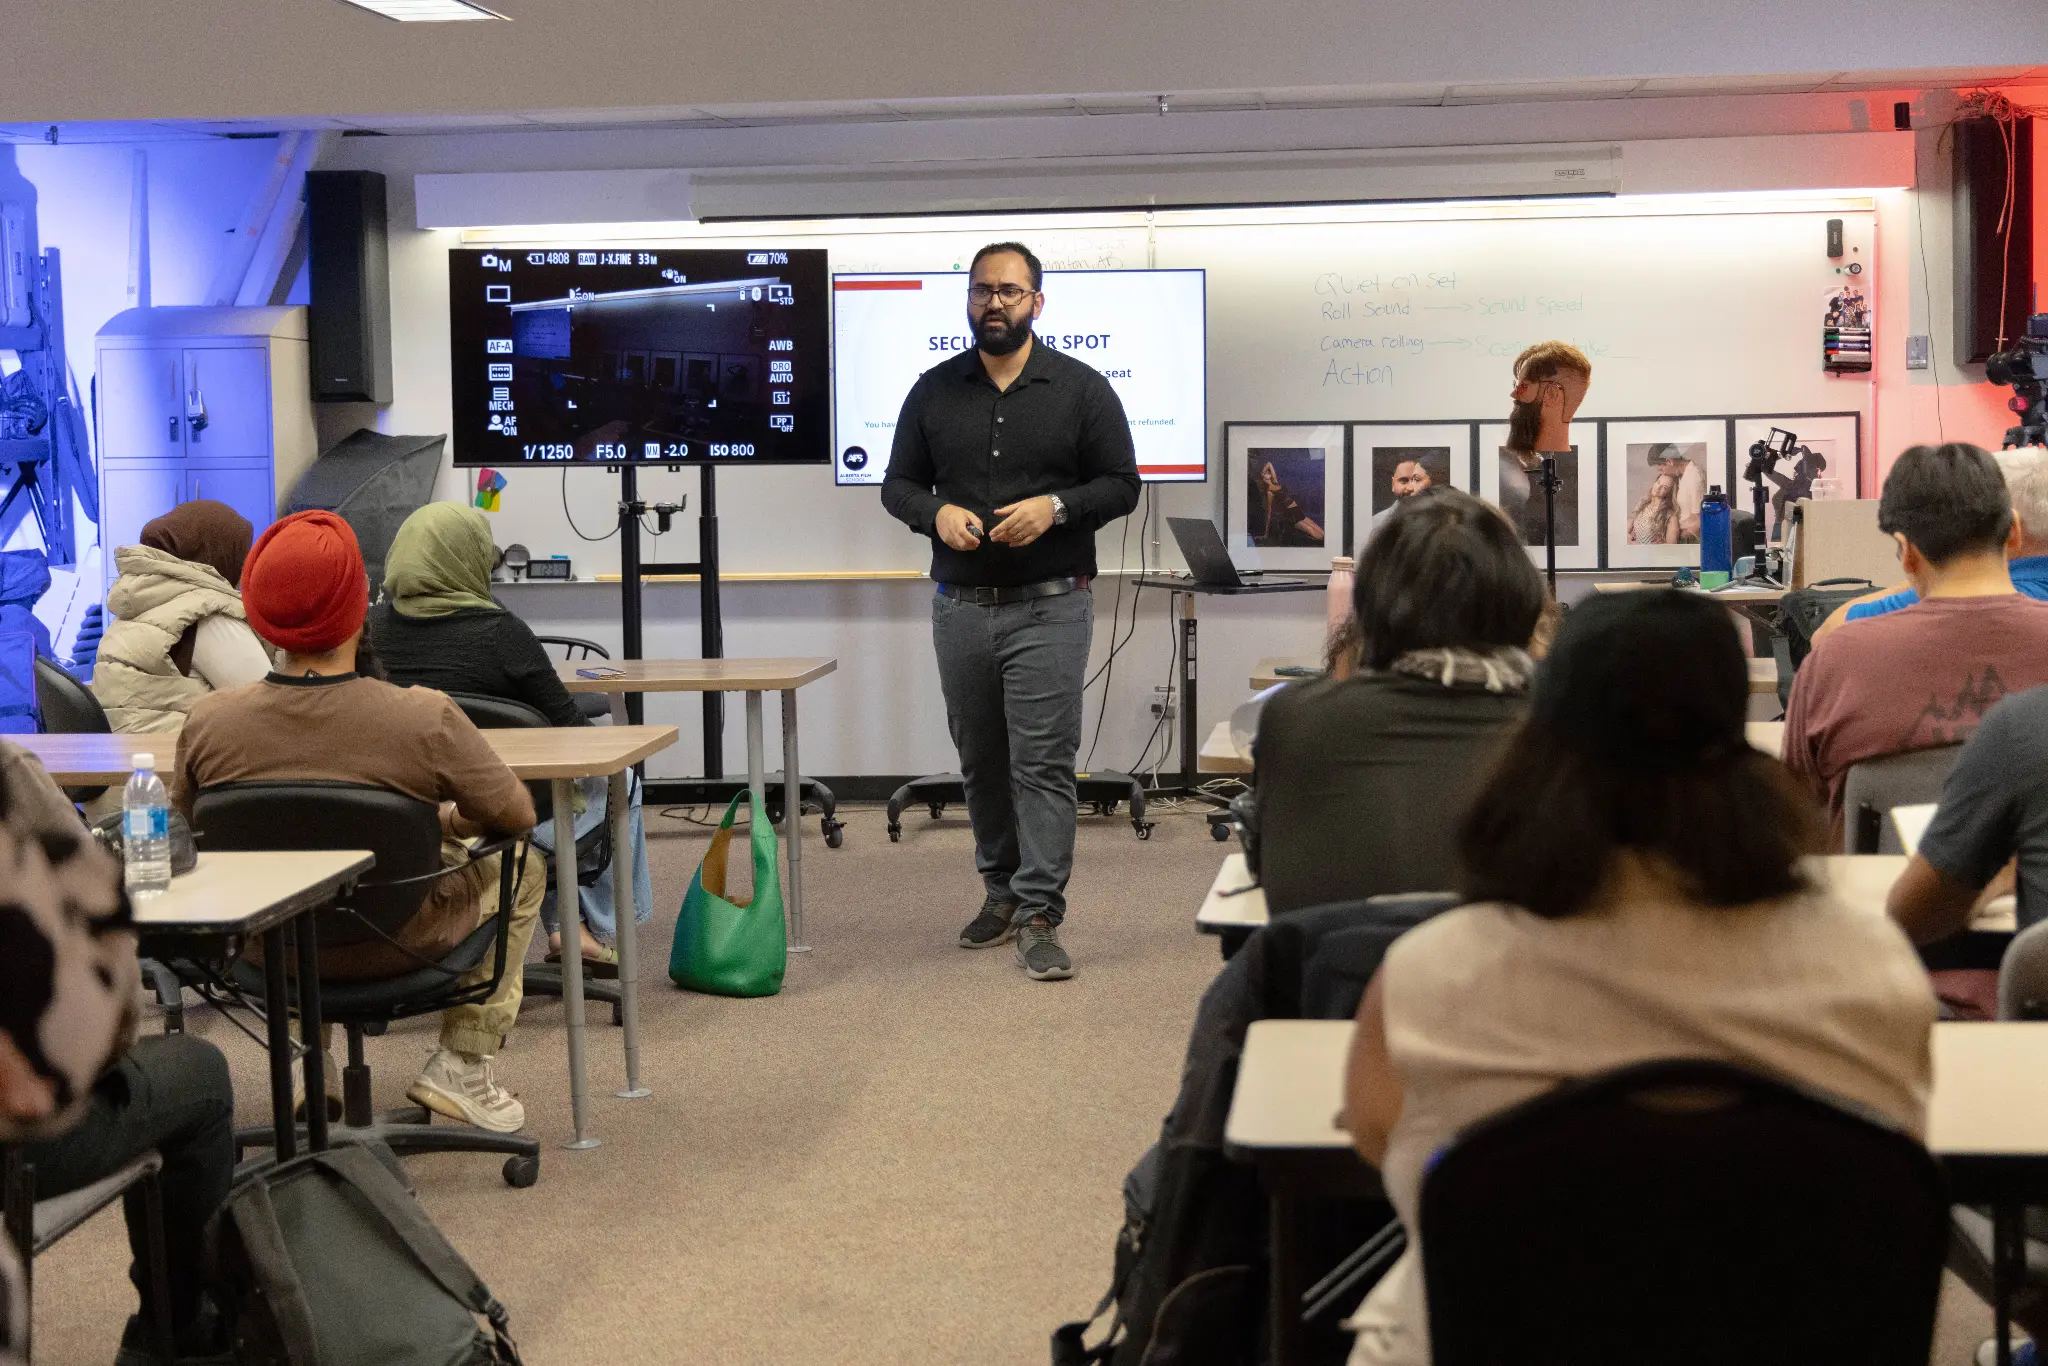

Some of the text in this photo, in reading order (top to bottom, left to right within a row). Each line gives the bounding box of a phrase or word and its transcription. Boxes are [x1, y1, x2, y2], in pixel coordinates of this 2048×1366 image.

[547, 253, 570, 265] 4808
[579, 255, 596, 264] RAW
[600, 254, 632, 265] J-X.FINE
[638, 253, 658, 265] 33M
[769, 253, 788, 265] 70%
[499, 260, 512, 272] M
[674, 275, 687, 284] ON
[582, 292, 595, 301] ON
[779, 297, 794, 305] STD
[1321, 301, 1351, 321] Roll
[1363, 298, 1410, 318] Sound
[489, 341, 512, 352] AF-A
[769, 340, 793, 351] AWB
[929, 336, 974, 351] SECU
[1062, 334, 1111, 350] SPOT
[1320, 335, 1375, 351] Camera
[1381, 335, 1424, 355] rolling
[1475, 334, 1527, 357] Scen
[772, 362, 791, 371] DRO
[770, 373, 793, 383] AUTO
[1105, 368, 1132, 378] seat
[1322, 358, 1393, 390] Action
[489, 401, 514, 411] MECH
[504, 416, 517, 426] AF
[777, 418, 788, 426] PP
[1138, 418, 1176, 426] refunded.
[502, 427, 517, 436] ON
[781, 425, 794, 433] OFF
[596, 444, 627, 459] F5.0
[664, 444, 689, 457] -2.0
[710, 444, 729, 457] ISO
[731, 444, 755, 457] 800
[846, 454, 864, 463] AFS
